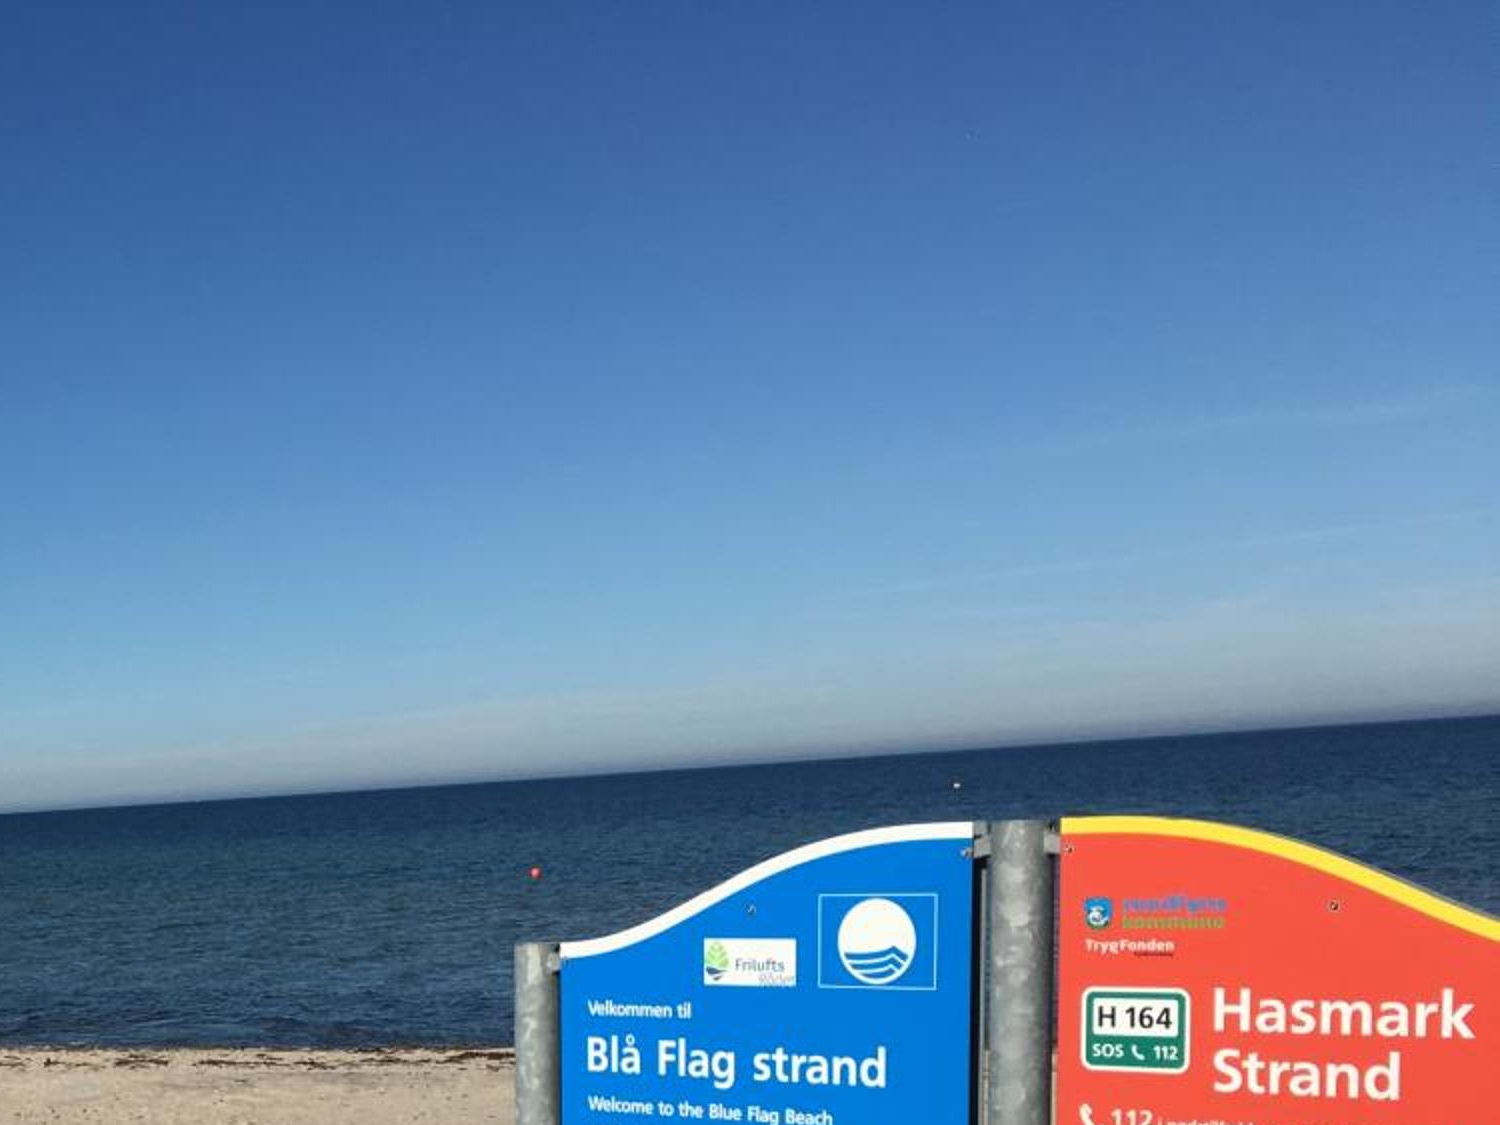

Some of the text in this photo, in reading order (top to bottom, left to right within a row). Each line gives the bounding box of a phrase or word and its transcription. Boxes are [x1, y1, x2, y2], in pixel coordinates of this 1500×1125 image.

[1085, 939, 1174, 954] TrygFonden
[735, 959, 785, 972] Frilufts
[588, 1000, 691, 1018] Velkommen til
[1098, 1006, 1172, 1029] H 164
[1213, 988, 1475, 1039] Hasmark
[587, 1034, 887, 1089] Blå Flag strand
[1092, 1044, 1178, 1060] SOS 112
[1213, 1048, 1401, 1100] Strand
[588, 1097, 653, 1116] Welcome
[659, 1102, 674, 1116] to
[679, 1102, 703, 1118] the
[709, 1104, 741, 1121] Blue
